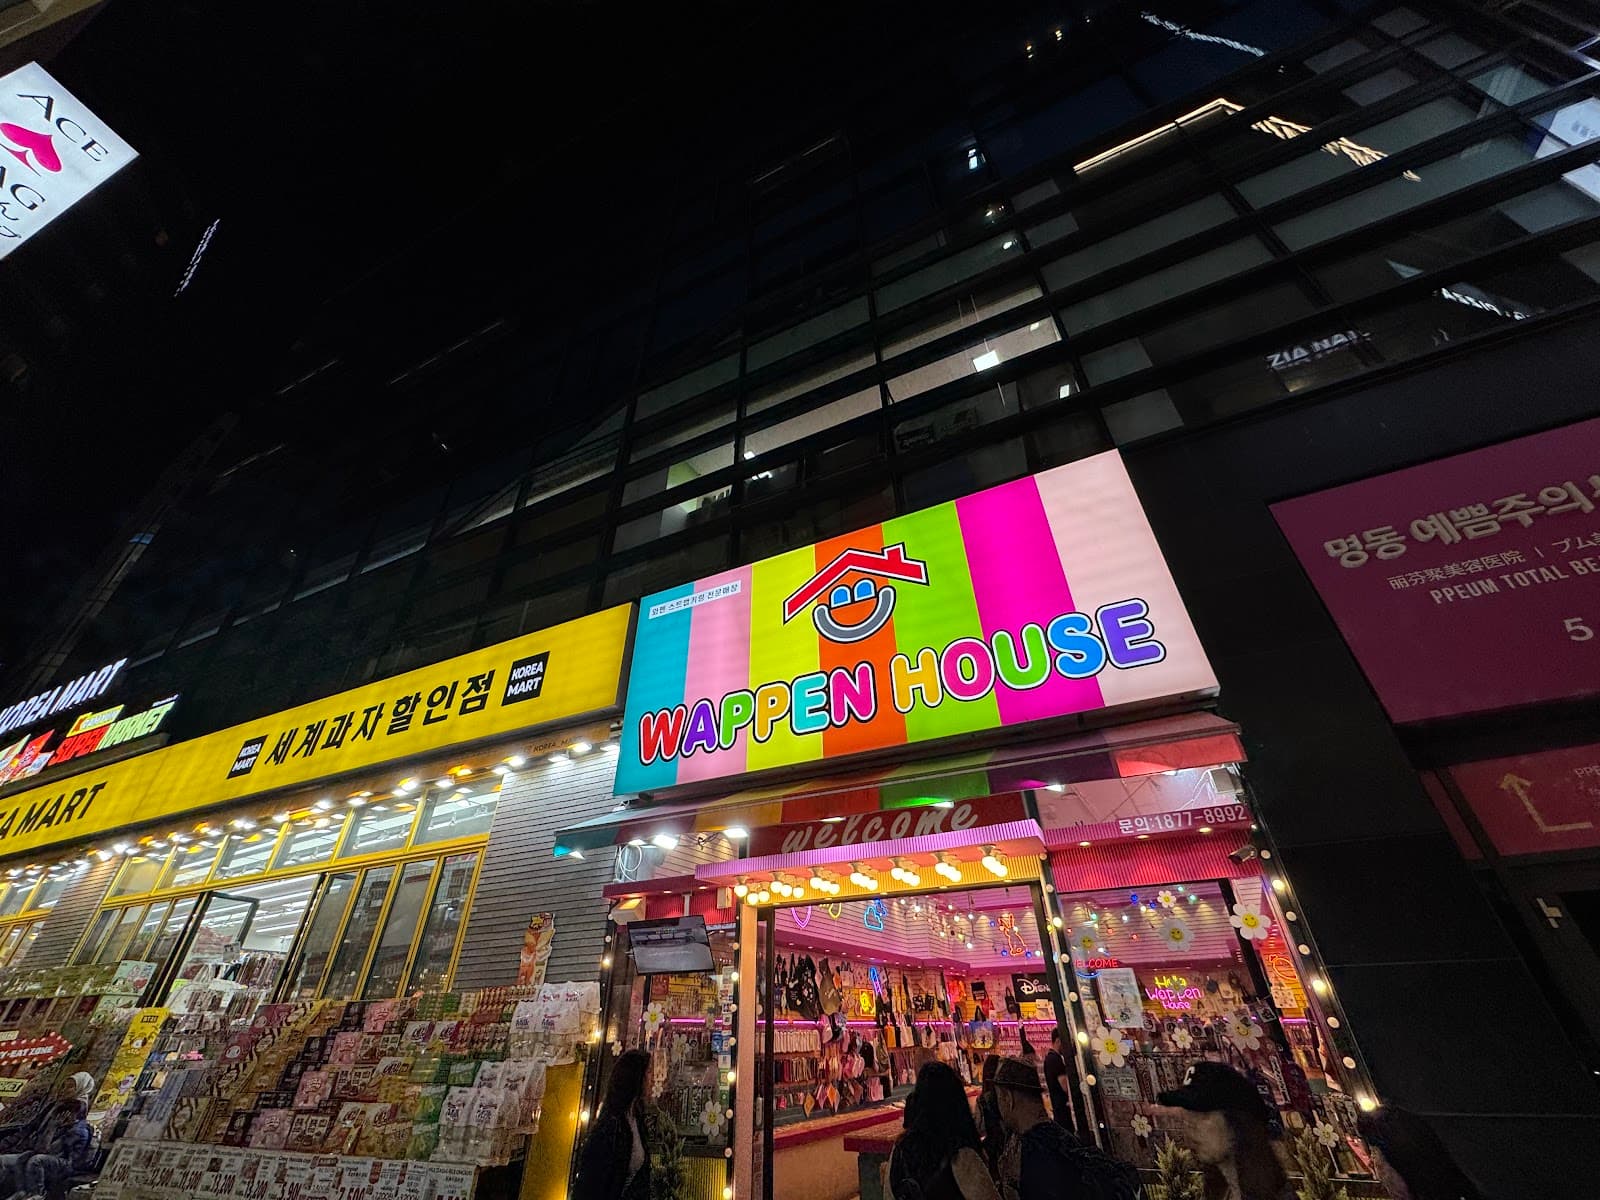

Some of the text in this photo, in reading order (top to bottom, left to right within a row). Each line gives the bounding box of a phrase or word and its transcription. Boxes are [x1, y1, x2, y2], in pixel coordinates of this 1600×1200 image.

[16, 93, 109, 162] ACE
[1323, 525, 1407, 568] 명동
[1429, 556, 1600, 604] PPEUM TOTAL BE
[1563, 617, 1594, 641] 5
[49, 657, 128, 715] MART
[506, 676, 542, 697] MART
[511, 661, 544, 681] KOREA
[638, 598, 1166, 766] WAPPEN HOUSE
[48, 725, 112, 767] SUPER
[96, 701, 175, 752] MARKET
[239, 743, 262, 758] KOREA
[231, 756, 257, 772] MART
[12, 781, 108, 838] MART
[779, 803, 979, 854] welcome
